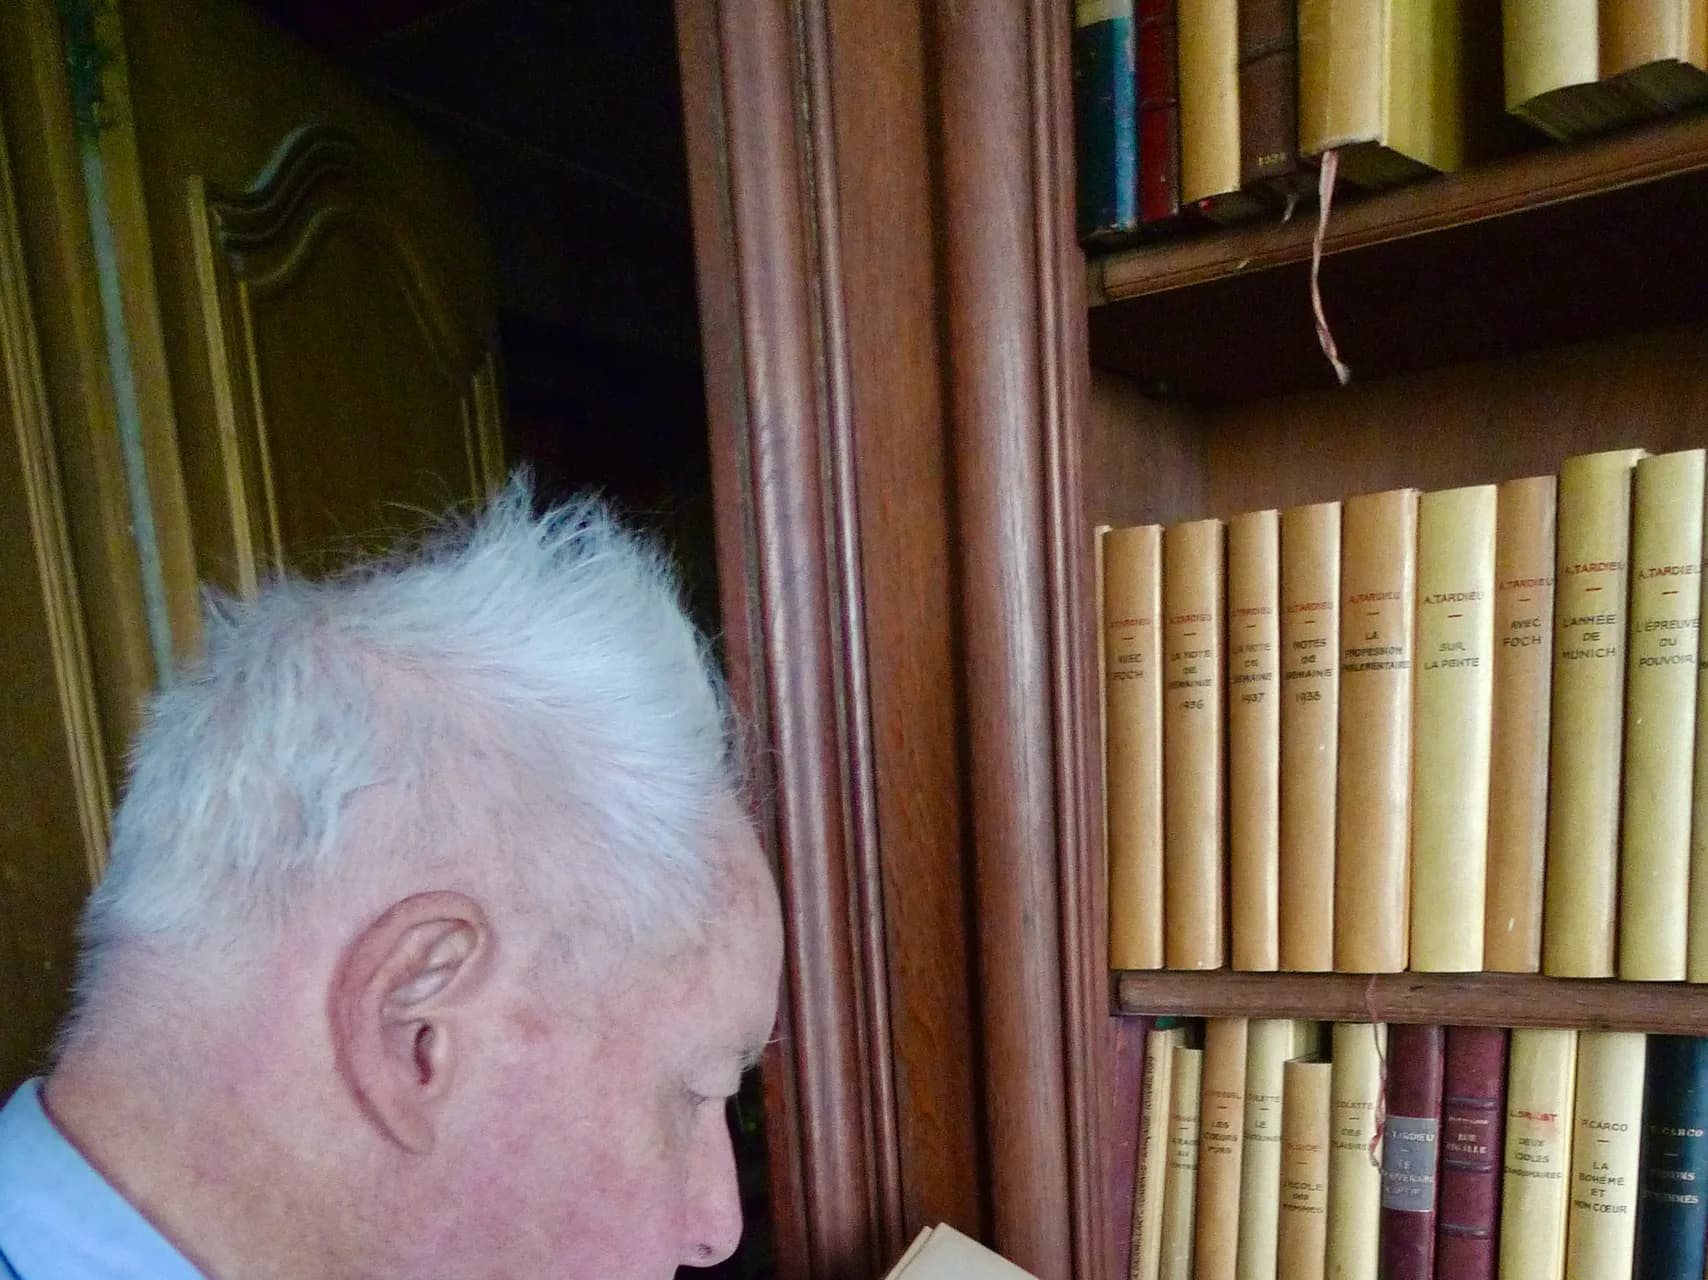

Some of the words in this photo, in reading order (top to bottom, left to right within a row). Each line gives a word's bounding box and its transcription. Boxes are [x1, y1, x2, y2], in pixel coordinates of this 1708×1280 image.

[1510, 618, 1542, 630] AVEC
[1503, 635, 1542, 647] FOCH
[1583, 632, 1601, 642] DE
[1293, 639, 1327, 650] NOTES
[1659, 638, 1678, 648] DU
[1563, 648, 1617, 660] MUNICH
[1640, 654, 1696, 668] POUVOIR
[1519, 1137, 1545, 1147] DEUX
[1593, 1161, 1609, 1170] LA
[1591, 1188, 1606, 1197] ET
